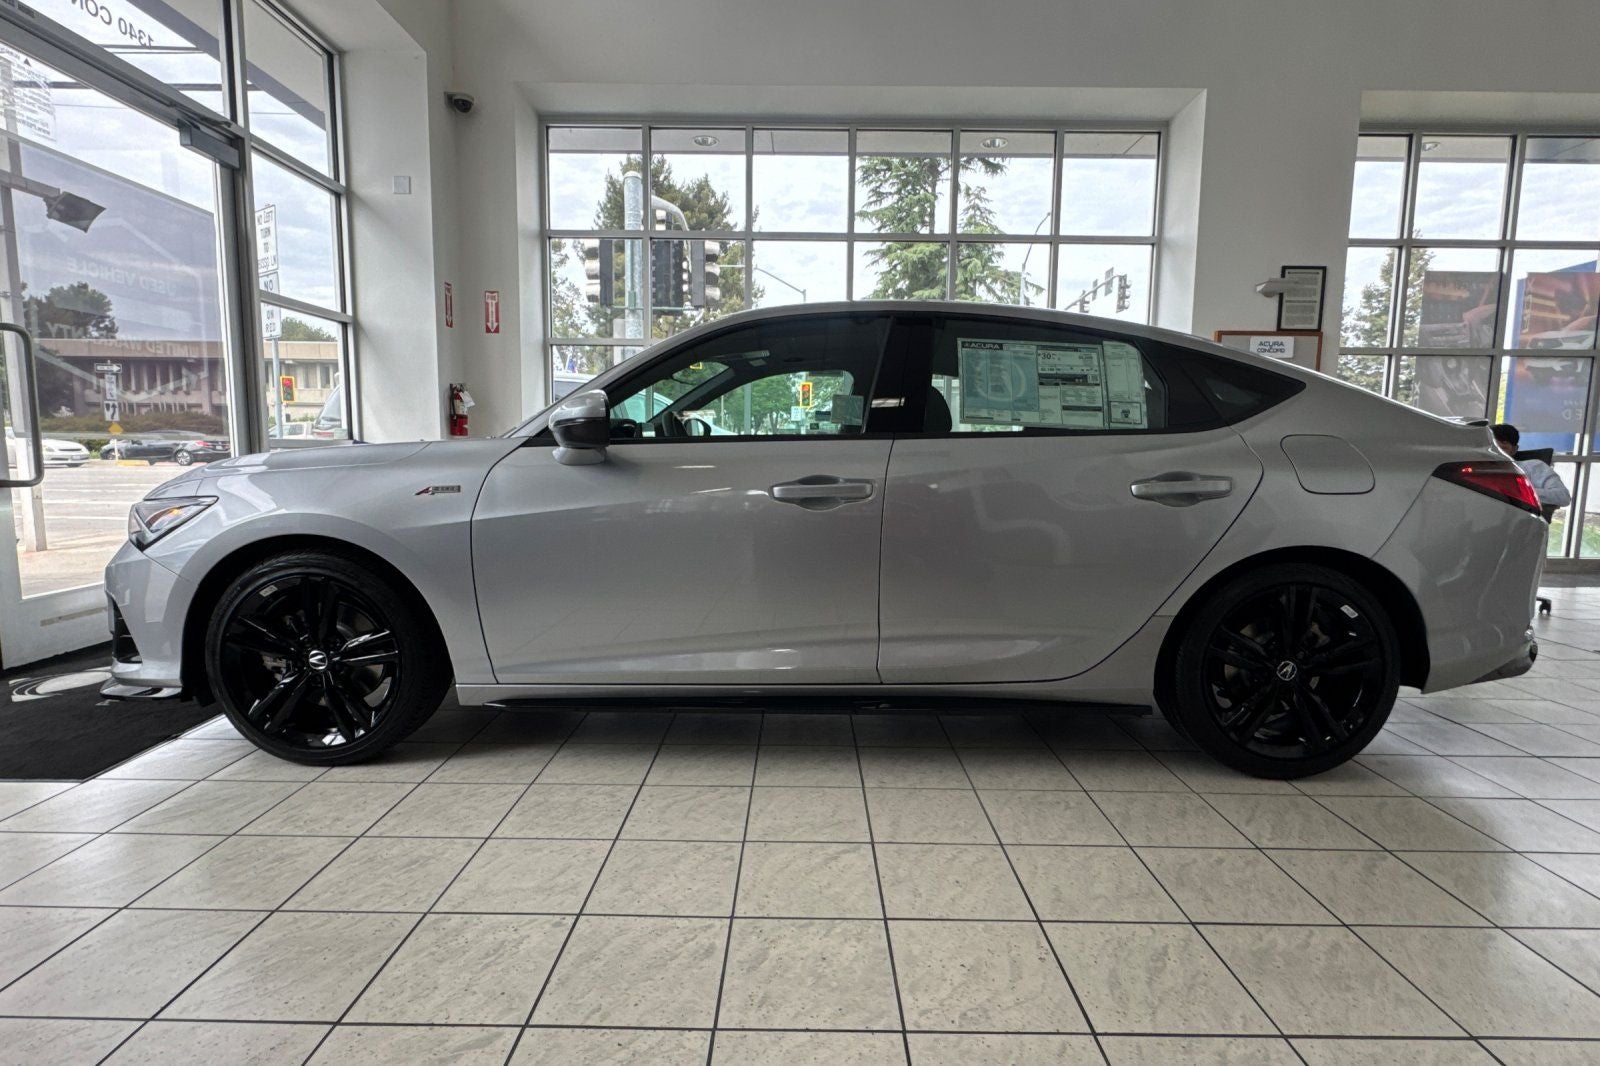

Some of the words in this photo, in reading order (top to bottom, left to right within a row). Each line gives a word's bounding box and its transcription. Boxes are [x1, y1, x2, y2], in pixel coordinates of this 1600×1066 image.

[263, 210, 273, 223] LEFT
[263, 279, 273, 292] NO
[266, 309, 275, 320] ON
[265, 322, 276, 333] RED
[970, 342, 1000, 350] ACURA
